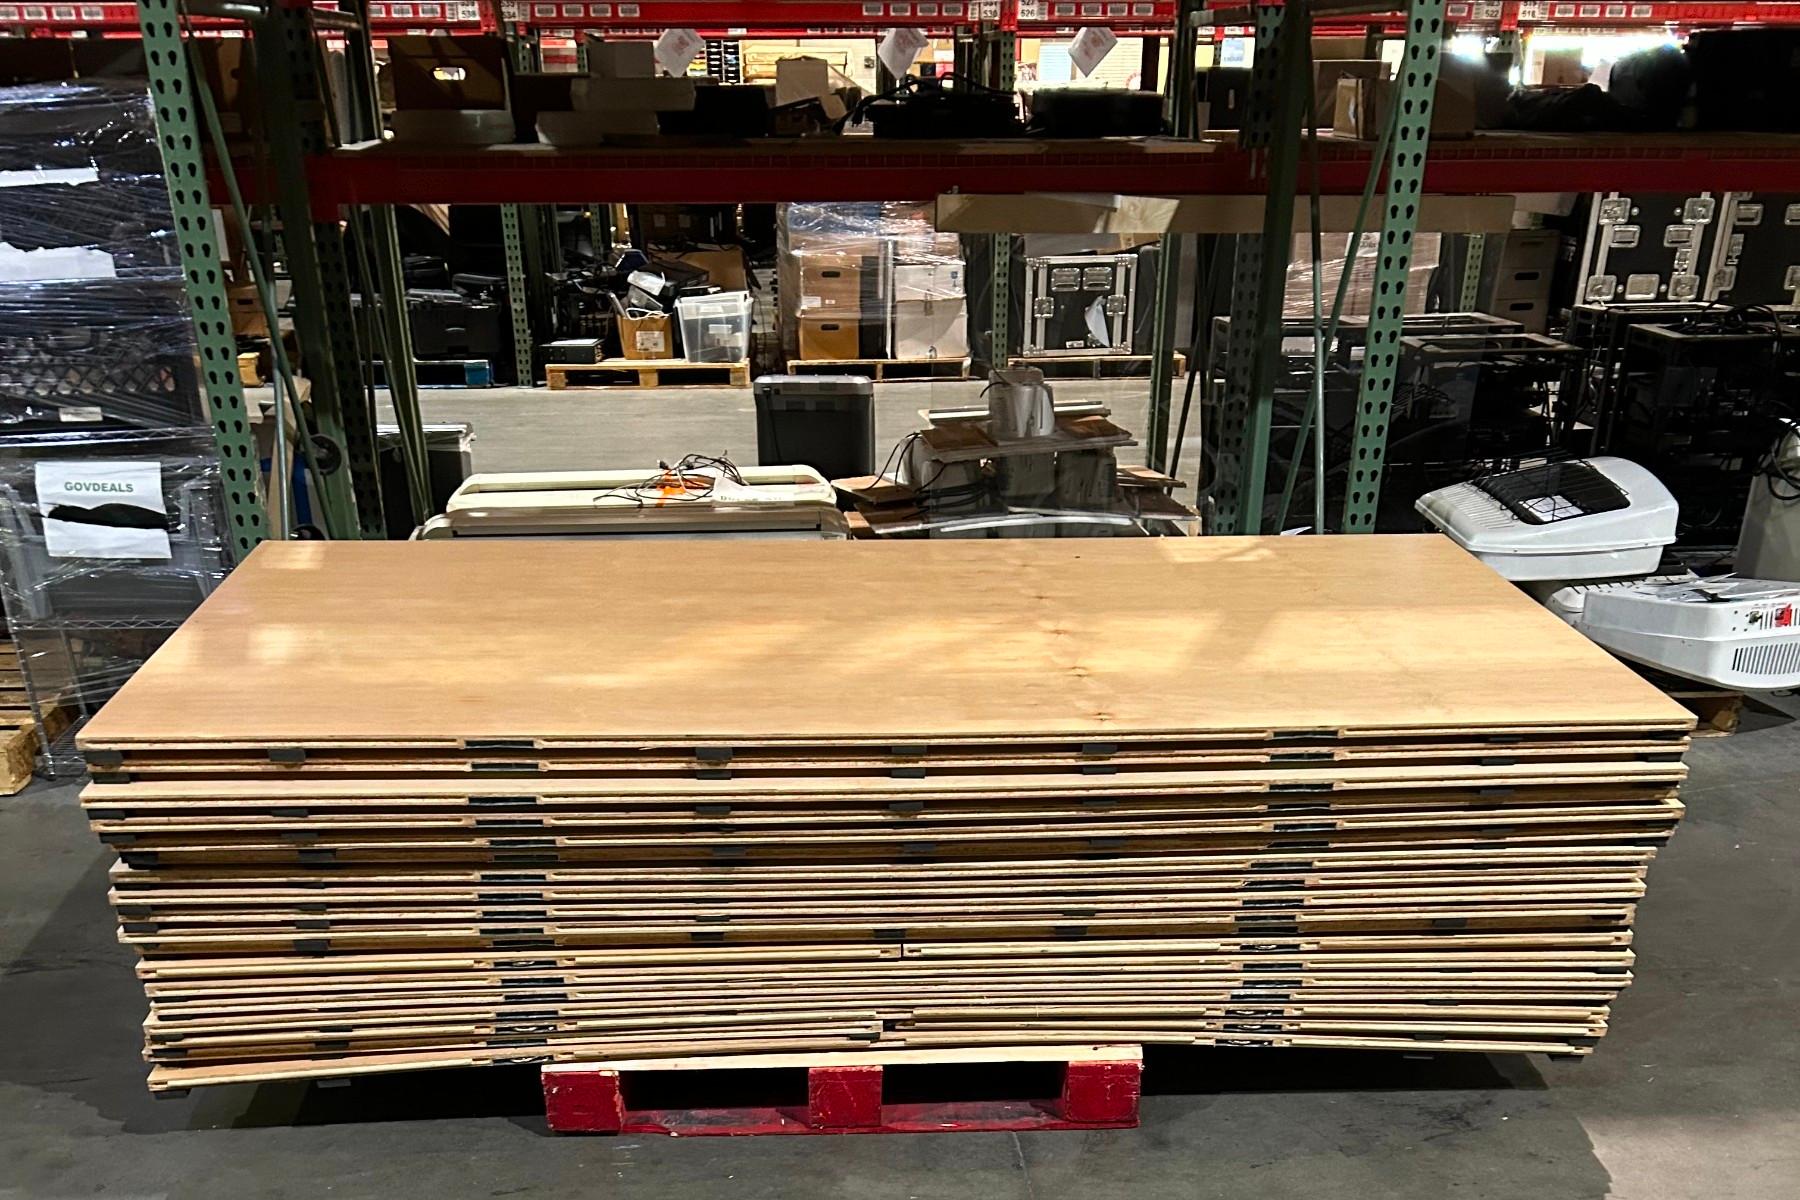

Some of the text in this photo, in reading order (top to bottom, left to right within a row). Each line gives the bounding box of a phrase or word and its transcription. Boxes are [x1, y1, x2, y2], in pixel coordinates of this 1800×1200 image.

[1020, 9, 1035, 18] 526
[1485, 9, 1500, 18] 522
[64, 481, 134, 493] GOVDEALS
